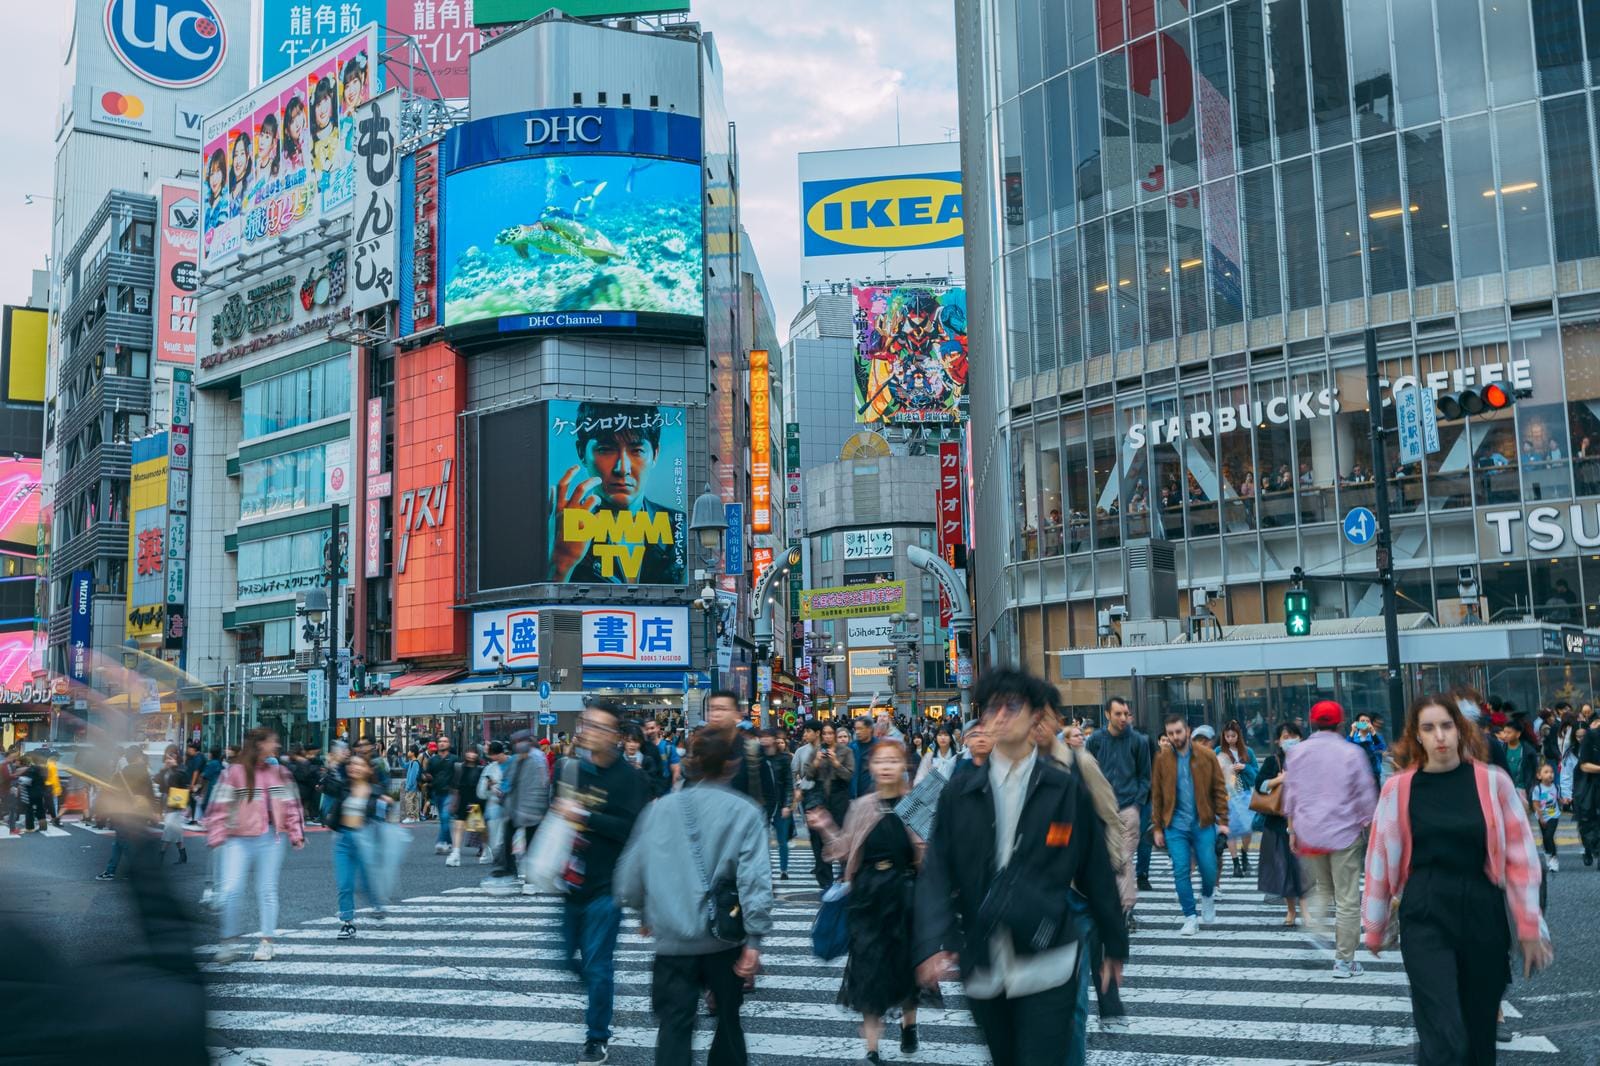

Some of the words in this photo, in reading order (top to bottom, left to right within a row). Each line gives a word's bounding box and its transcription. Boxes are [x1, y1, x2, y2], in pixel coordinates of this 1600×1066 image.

[290, 3, 362, 35] 龍角散
[102, 115, 143, 127] mastercard
[524, 114, 602, 145] DHC
[357, 102, 394, 298] もんじゃ
[824, 194, 963, 231] IKEA
[529, 316, 554, 327] DHC
[556, 314, 602, 326] Channel
[552, 411, 683, 436] ケンシロウによろしく
[1129, 387, 1340, 449] STARBUCKS
[1405, 393, 1420, 455] 渋谷駅前
[134, 467, 161, 481] Matsumoto
[942, 453, 960, 534] カラオケ
[563, 508, 674, 545] DMM
[857, 532, 892, 543] れいわ
[1486, 504, 1600, 553] TSU
[593, 544, 646, 578] TV
[846, 545, 892, 557] クリニック
[79, 579, 88, 615] MIZUHO
